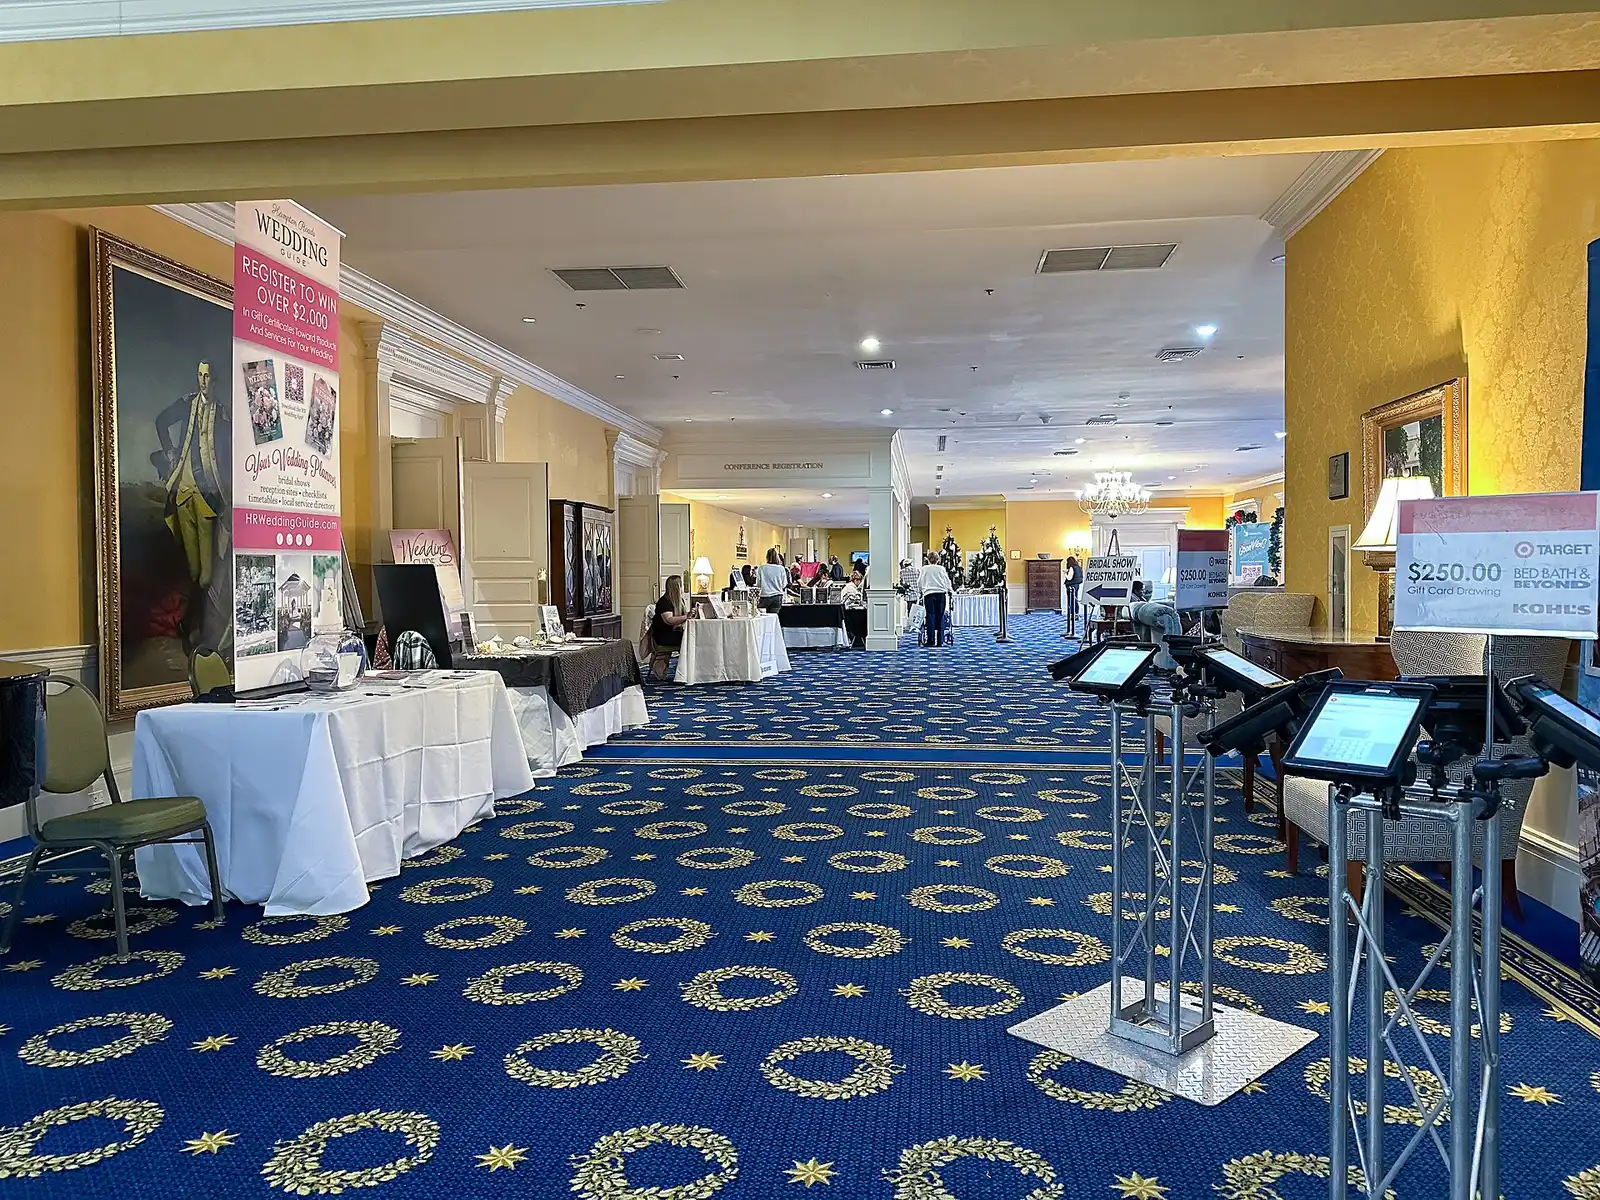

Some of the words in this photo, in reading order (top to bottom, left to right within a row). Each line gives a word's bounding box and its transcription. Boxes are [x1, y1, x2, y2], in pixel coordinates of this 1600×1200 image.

[255, 208, 328, 267] WEDDING
[280, 248, 307, 267] GUIDE
[242, 255, 296, 295] REGISTER
[300, 283, 315, 303] TO
[318, 291, 337, 314] WIN
[257, 286, 289, 314] OVER
[293, 301, 328, 330] $2,000
[242, 306, 250, 317] In
[251, 309, 263, 321] Gift
[263, 314, 295, 335] Certificates
[295, 327, 316, 342] Toward
[317, 335, 337, 351] Products
[250, 324, 264, 336] And
[264, 329, 287, 345] Services
[287, 337, 297, 348] For
[296, 341, 310, 353] Your
[310, 345, 334, 364] Wedding
[245, 451, 271, 482] Your
[272, 446, 308, 476] Wedding
[310, 454, 337, 489] Planner
[772, 462, 823, 470] REGISTRATION
[278, 475, 293, 485] bridal
[260, 485, 285, 496] reception
[286, 488, 298, 496] sites
[302, 490, 327, 499] checklists
[248, 494, 278, 505] timetables
[282, 497, 294, 506] local
[295, 500, 313, 508] service
[314, 501, 336, 512] directory
[245, 513, 338, 530] HRWeddingGuide.com
[401, 532, 453, 564] Wedding
[1537, 543, 1592, 556] TARGET
[1089, 559, 1110, 568] BRIDAL
[1112, 558, 1134, 568] SHOW
[1086, 571, 1134, 581] REGISTRATION
[1180, 569, 1206, 582] $250.00
[1408, 561, 1501, 584] $250.00
[1514, 567, 1539, 580] BED
[1542, 567, 1577, 580] BATH
[1579, 568, 1591, 580] &
[1408, 586, 1426, 595] Gift
[1428, 586, 1454, 595] Card
[1457, 586, 1501, 598] Drawing
[1514, 580, 1591, 589] BEYOND
[1512, 604, 1592, 616] KOHL'S
